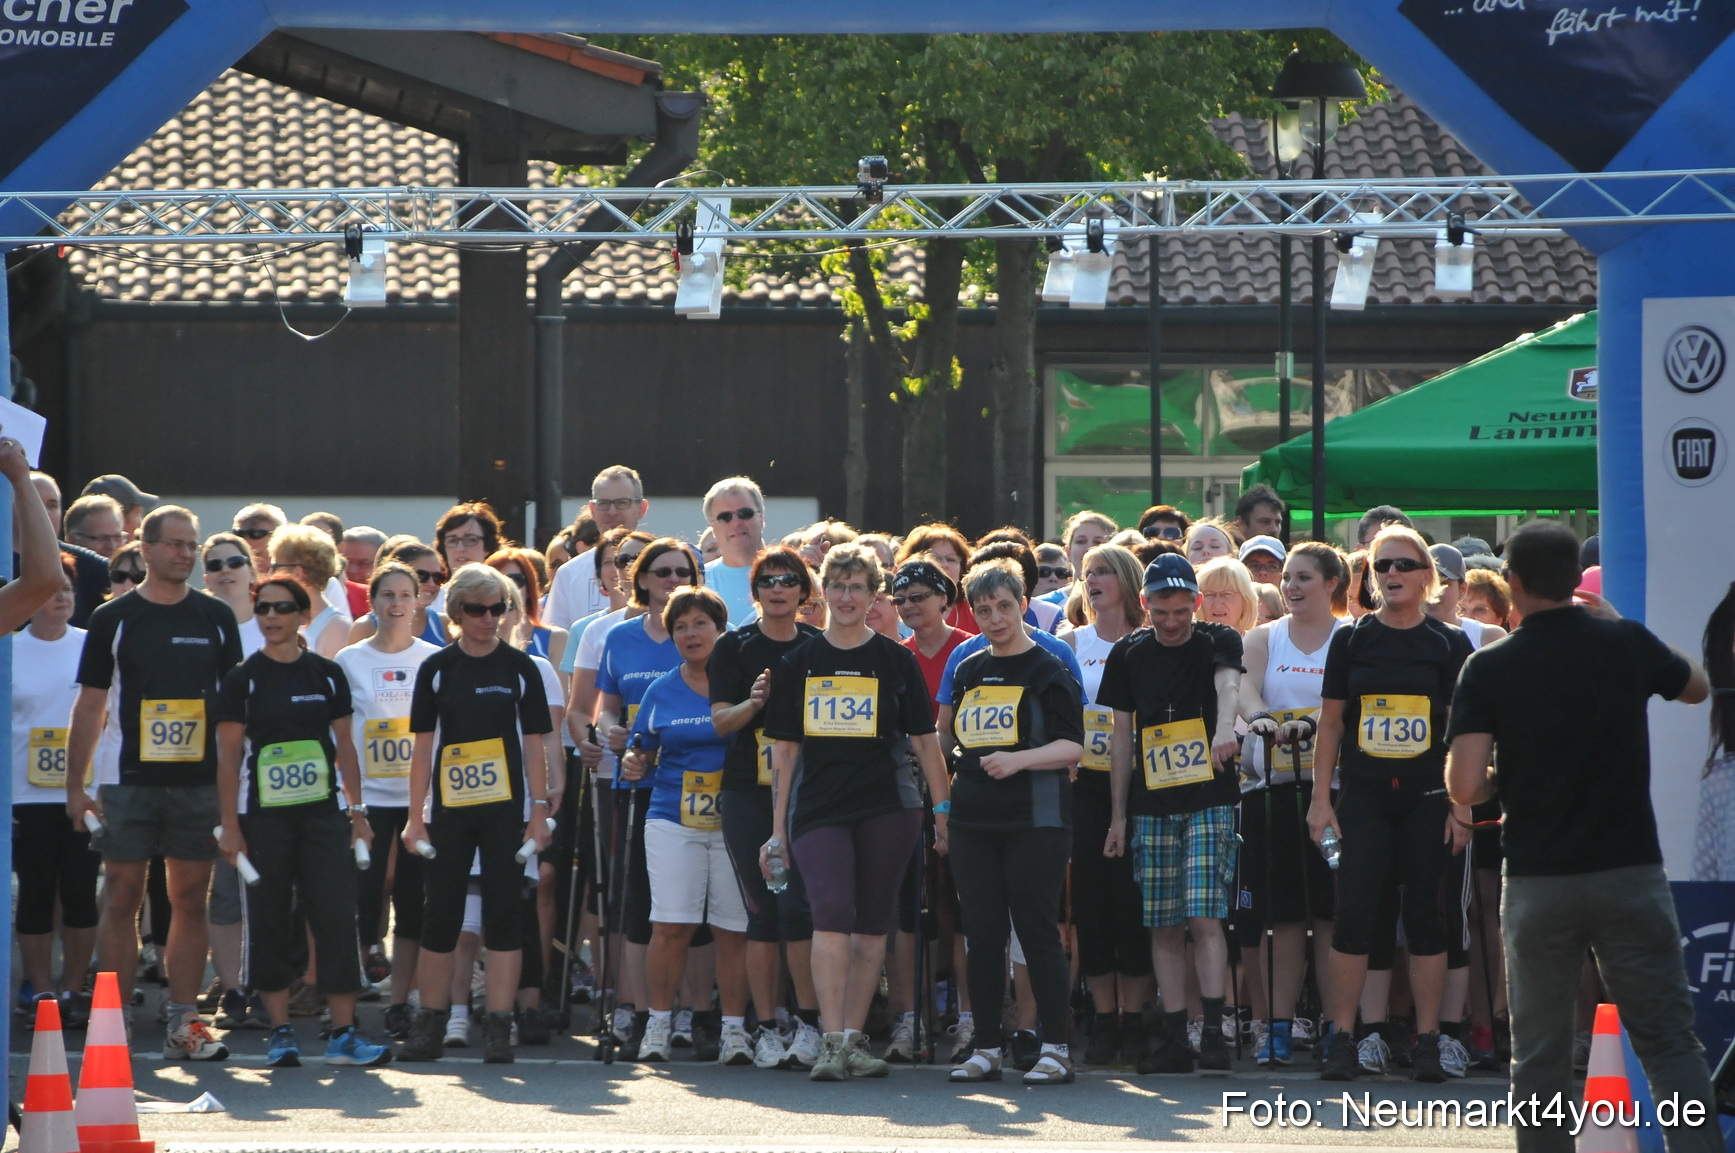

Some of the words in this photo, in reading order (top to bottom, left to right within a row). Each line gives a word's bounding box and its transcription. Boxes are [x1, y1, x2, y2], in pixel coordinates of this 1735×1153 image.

[1546, 7, 1626, 45] fährt
[1677, 438, 1711, 467] FIAT
[808, 696, 874, 720] 1134
[959, 705, 1014, 732] 1126
[151, 721, 198, 745] 987
[1363, 717, 1427, 742] 1130
[368, 738, 412, 762] 100
[1146, 741, 1207, 772] 1132
[269, 762, 317, 790] 986
[448, 762, 497, 790] 985
